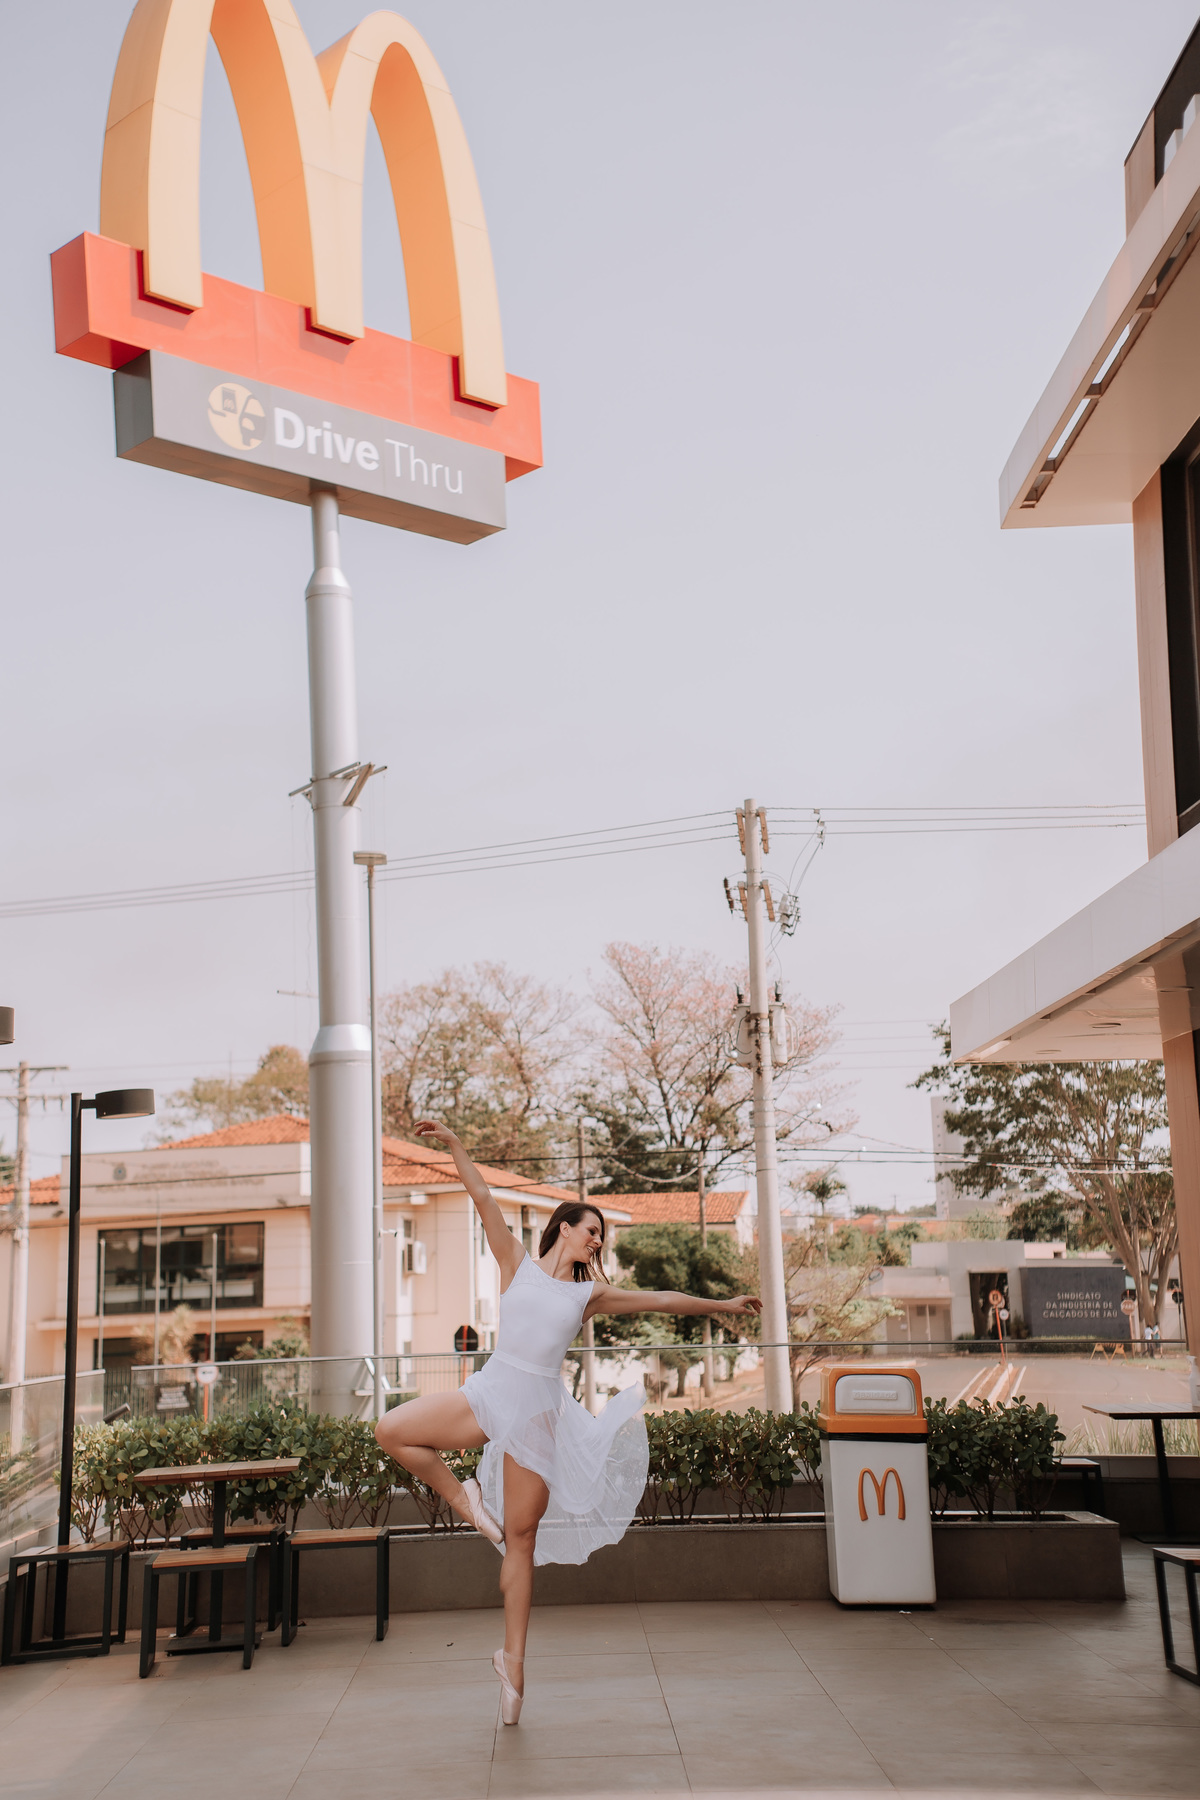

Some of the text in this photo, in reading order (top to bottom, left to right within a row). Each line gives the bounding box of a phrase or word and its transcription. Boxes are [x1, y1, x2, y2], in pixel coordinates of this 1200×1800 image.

[274, 407, 463, 494] Drive Thru
[1042, 1310, 1088, 1319] CALÇADOS
[1090, 1310, 1100, 1318] DE
[1045, 1301, 1057, 1309] DA
[1103, 1301, 1113, 1309] DE
[857, 1467, 906, 1521] M
